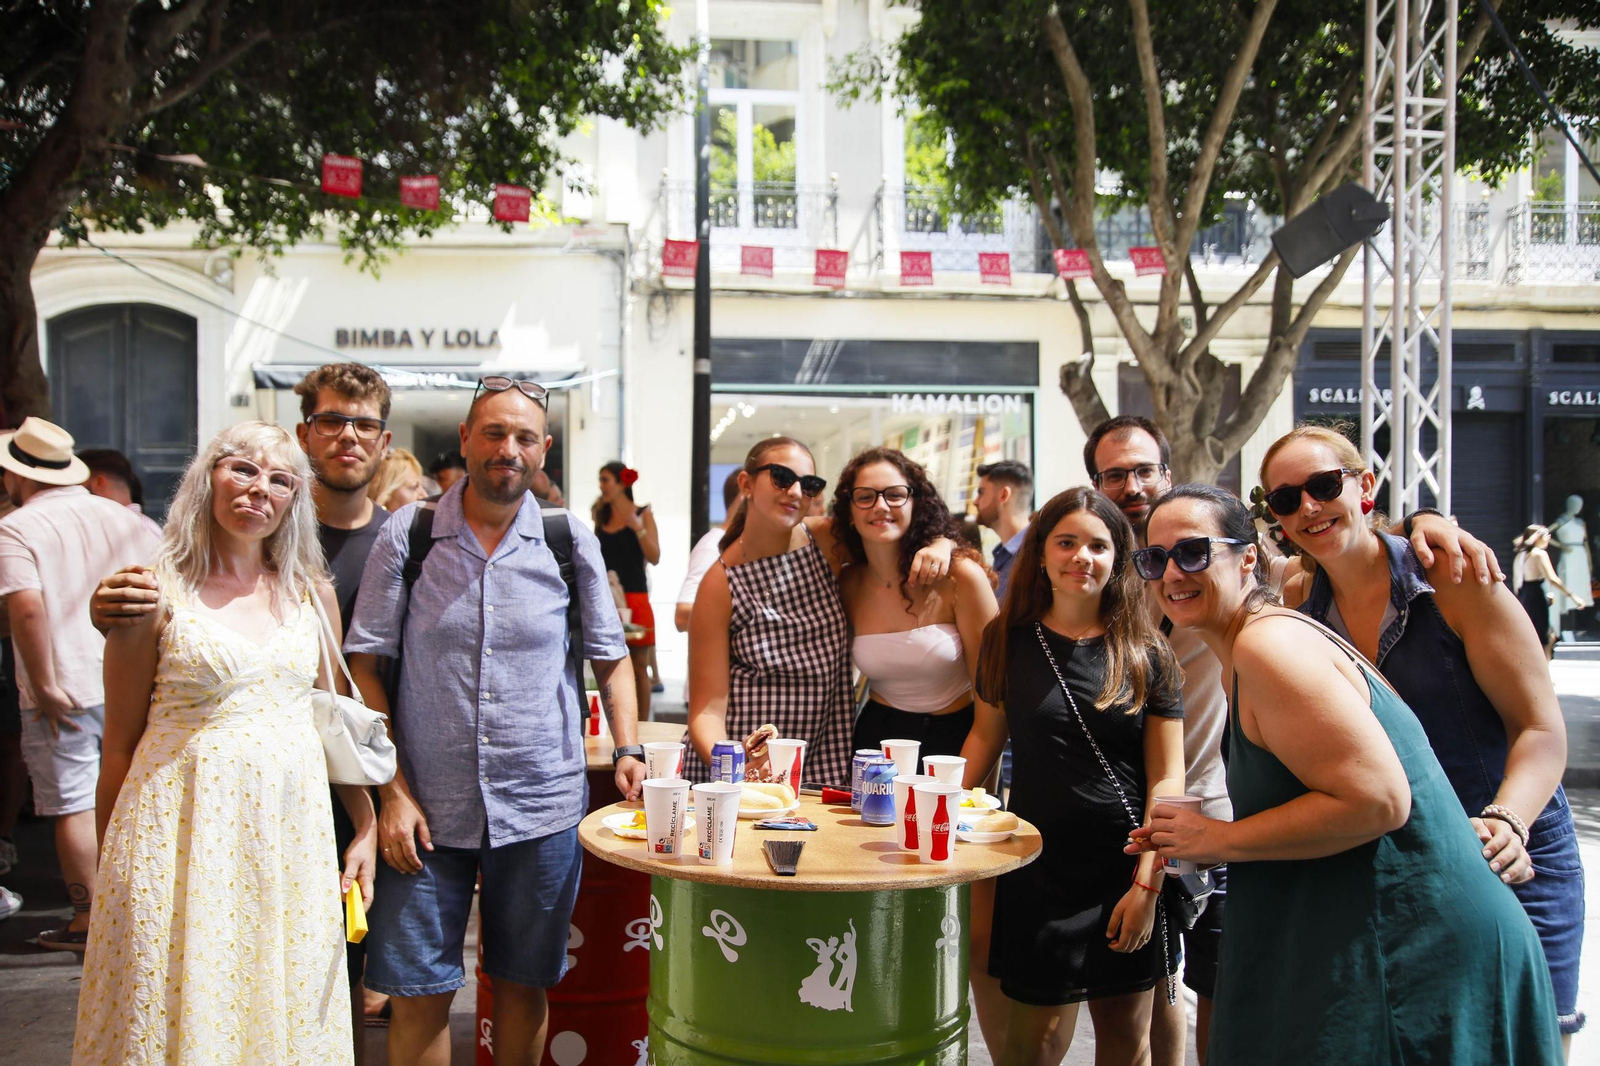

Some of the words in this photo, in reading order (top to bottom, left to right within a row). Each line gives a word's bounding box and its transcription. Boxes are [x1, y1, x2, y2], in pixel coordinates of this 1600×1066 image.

[335, 328, 413, 348] BIMBA
[420, 328, 434, 348] Y
[443, 328, 501, 348] LOLA
[891, 393, 1022, 414] KAMALION
